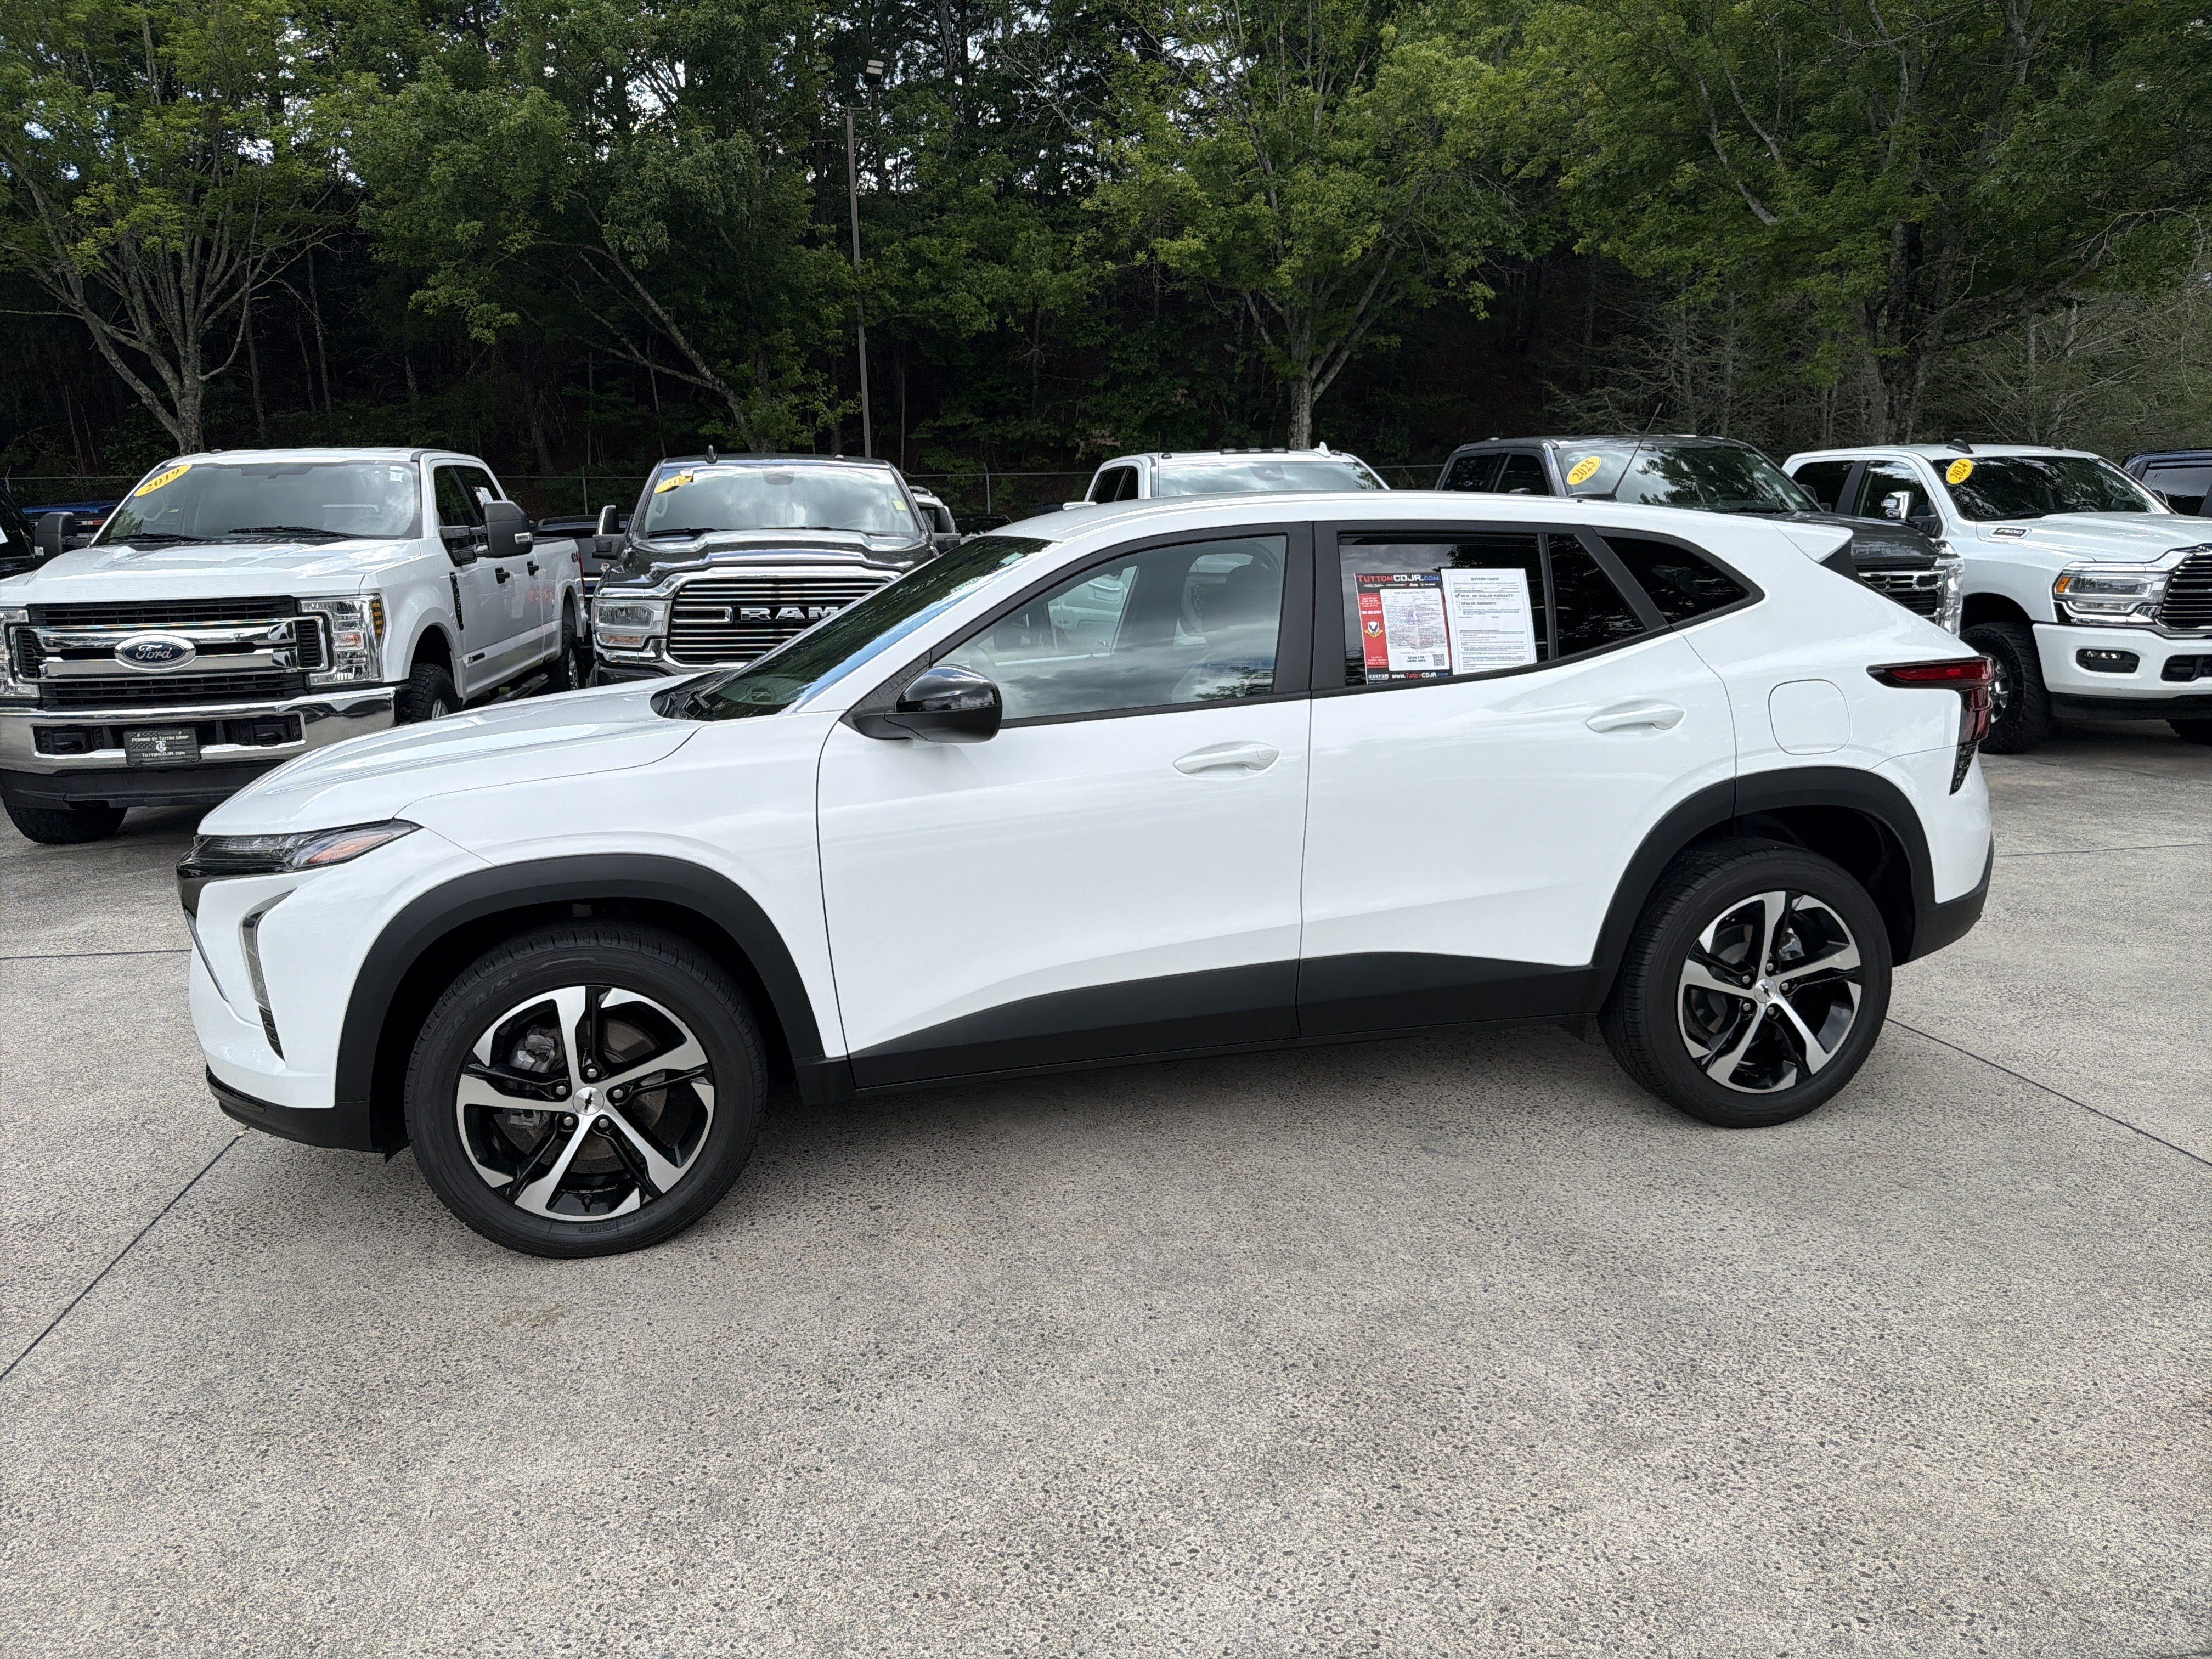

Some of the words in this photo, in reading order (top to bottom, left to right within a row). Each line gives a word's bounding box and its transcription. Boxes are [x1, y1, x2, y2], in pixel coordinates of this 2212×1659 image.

[1572, 459, 1595, 481] 2025
[1949, 461, 1969, 481] 2024
[145, 469, 180, 492] 2019
[1358, 574, 1440, 583] TUTTONCDJR.COM
[740, 607, 839, 620] RAM
[136, 644, 173, 659] Ford
